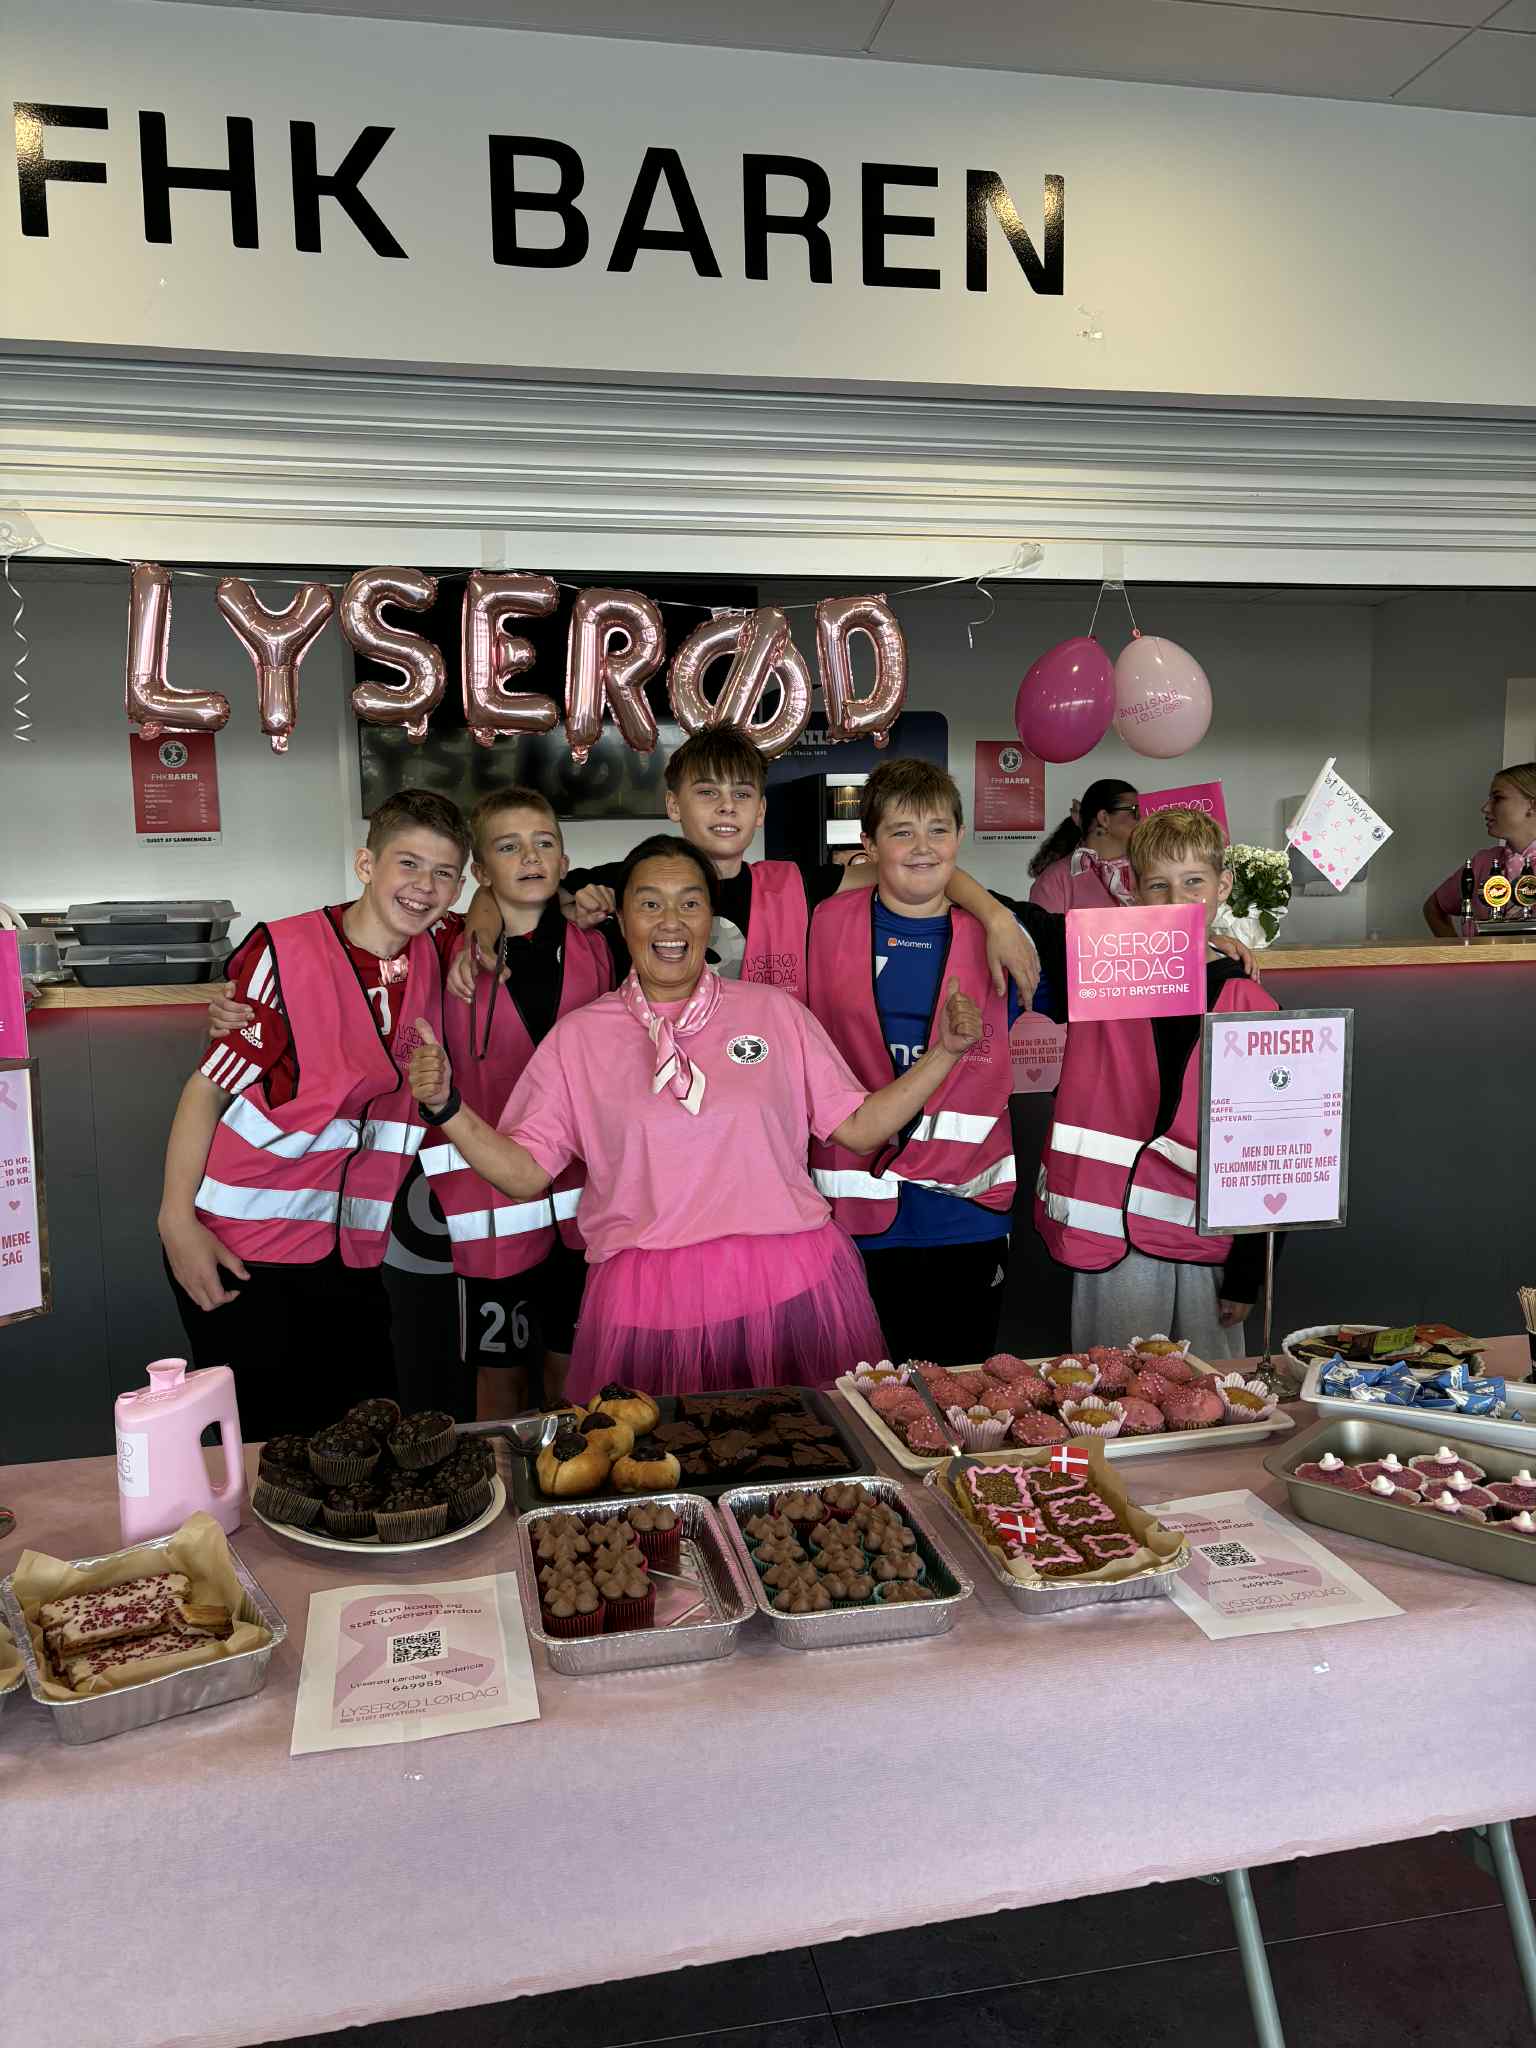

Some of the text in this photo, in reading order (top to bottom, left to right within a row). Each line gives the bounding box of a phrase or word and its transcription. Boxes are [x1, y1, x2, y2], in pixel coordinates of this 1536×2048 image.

[12, 101, 1067, 297] FHK BAREN
[125, 561, 908, 760] LYSERØD
[1077, 930, 1190, 958] LYSERØD
[1079, 956, 1185, 984] LØRDAG
[1099, 983, 1190, 998] STØT BRYSTERNE
[1247, 1029, 1315, 1057] PRISER
[1211, 1098, 1231, 1106] KAGE
[1242, 1143, 1312, 1159] MEN DU ER ALTID
[3, 1159, 14, 1167] 10
[5, 1168, 14, 1176] 10
[1214, 1155, 1338, 1174] VELKOMMEN TIL AT GIVE MERE
[6, 1178, 15, 1187] 10
[1221, 1170, 1330, 1188] FOR AT STØTTE EN GOD SAG
[1, 1231, 31, 1249] MERE
[2, 1250, 23, 1267] SAG
[479, 1300, 529, 1353] 26
[369, 1605, 401, 1617] Scan
[341, 1686, 499, 1718] LYSERØD LØRDAG
